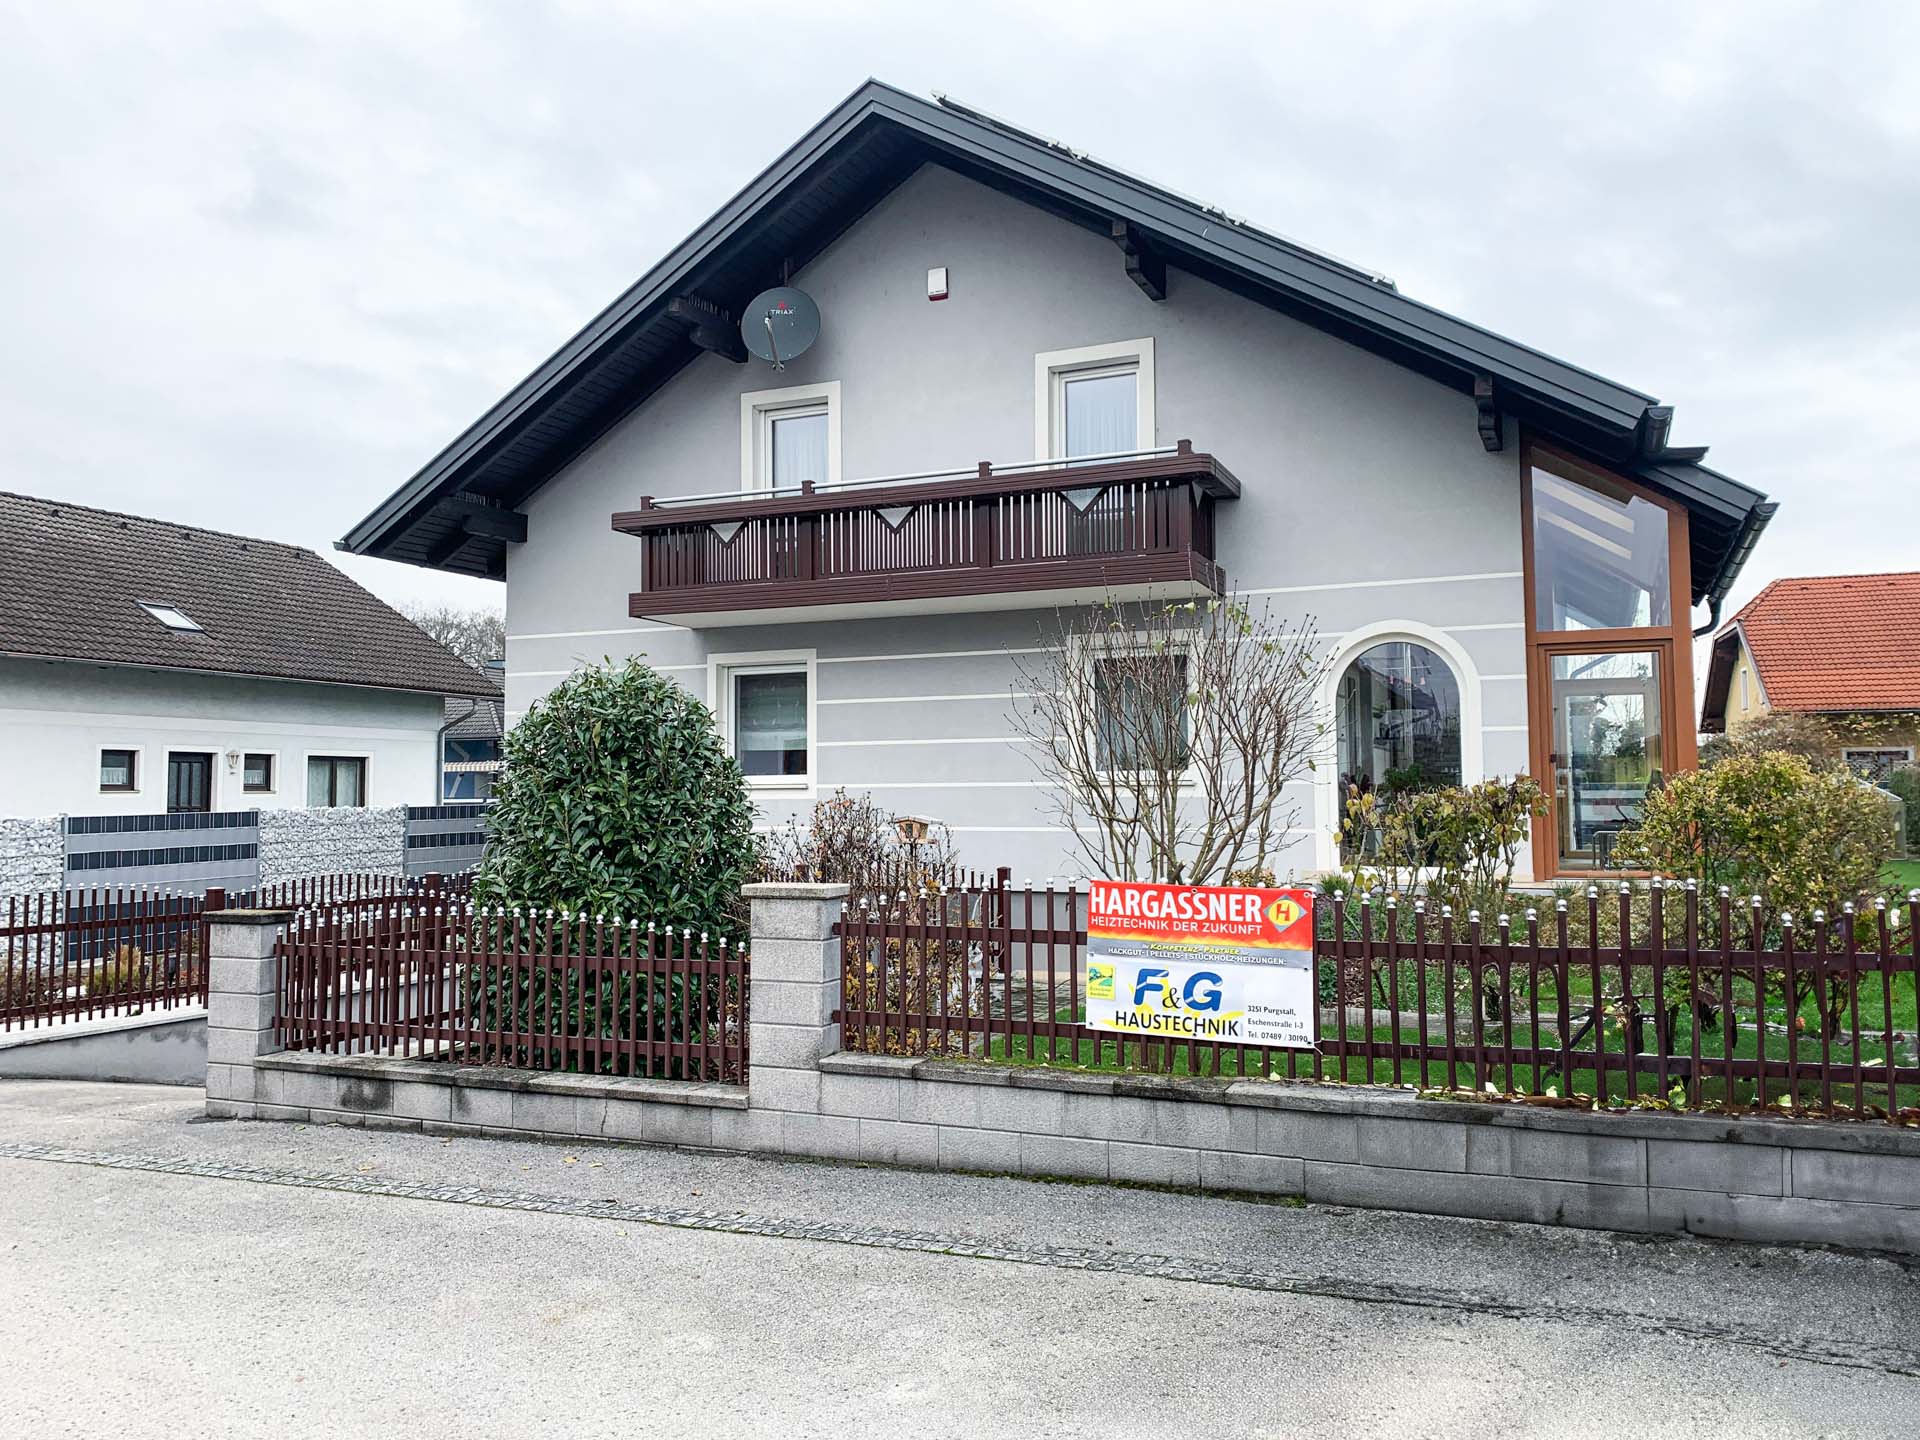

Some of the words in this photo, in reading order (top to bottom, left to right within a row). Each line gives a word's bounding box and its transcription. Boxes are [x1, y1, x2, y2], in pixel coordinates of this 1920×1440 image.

[1091, 886, 1263, 923] HARGASSNER
[1275, 903, 1290, 921] H
[1091, 916, 1169, 930] HEIZTECHNIK
[1173, 921, 1198, 932] DER
[1202, 923, 1263, 935] ZUKUNFT
[1247, 1005, 1262, 1013] 3251
[1263, 1006, 1297, 1016] Purgstall,
[1115, 1011, 1239, 1037] HAUSTECHNIK
[1248, 1018, 1293, 1029] Eschenstraße
[1248, 1031, 1259, 1040] Tel.
[1261, 1031, 1282, 1041] 07489
[1287, 1034, 1309, 1043] 30190
